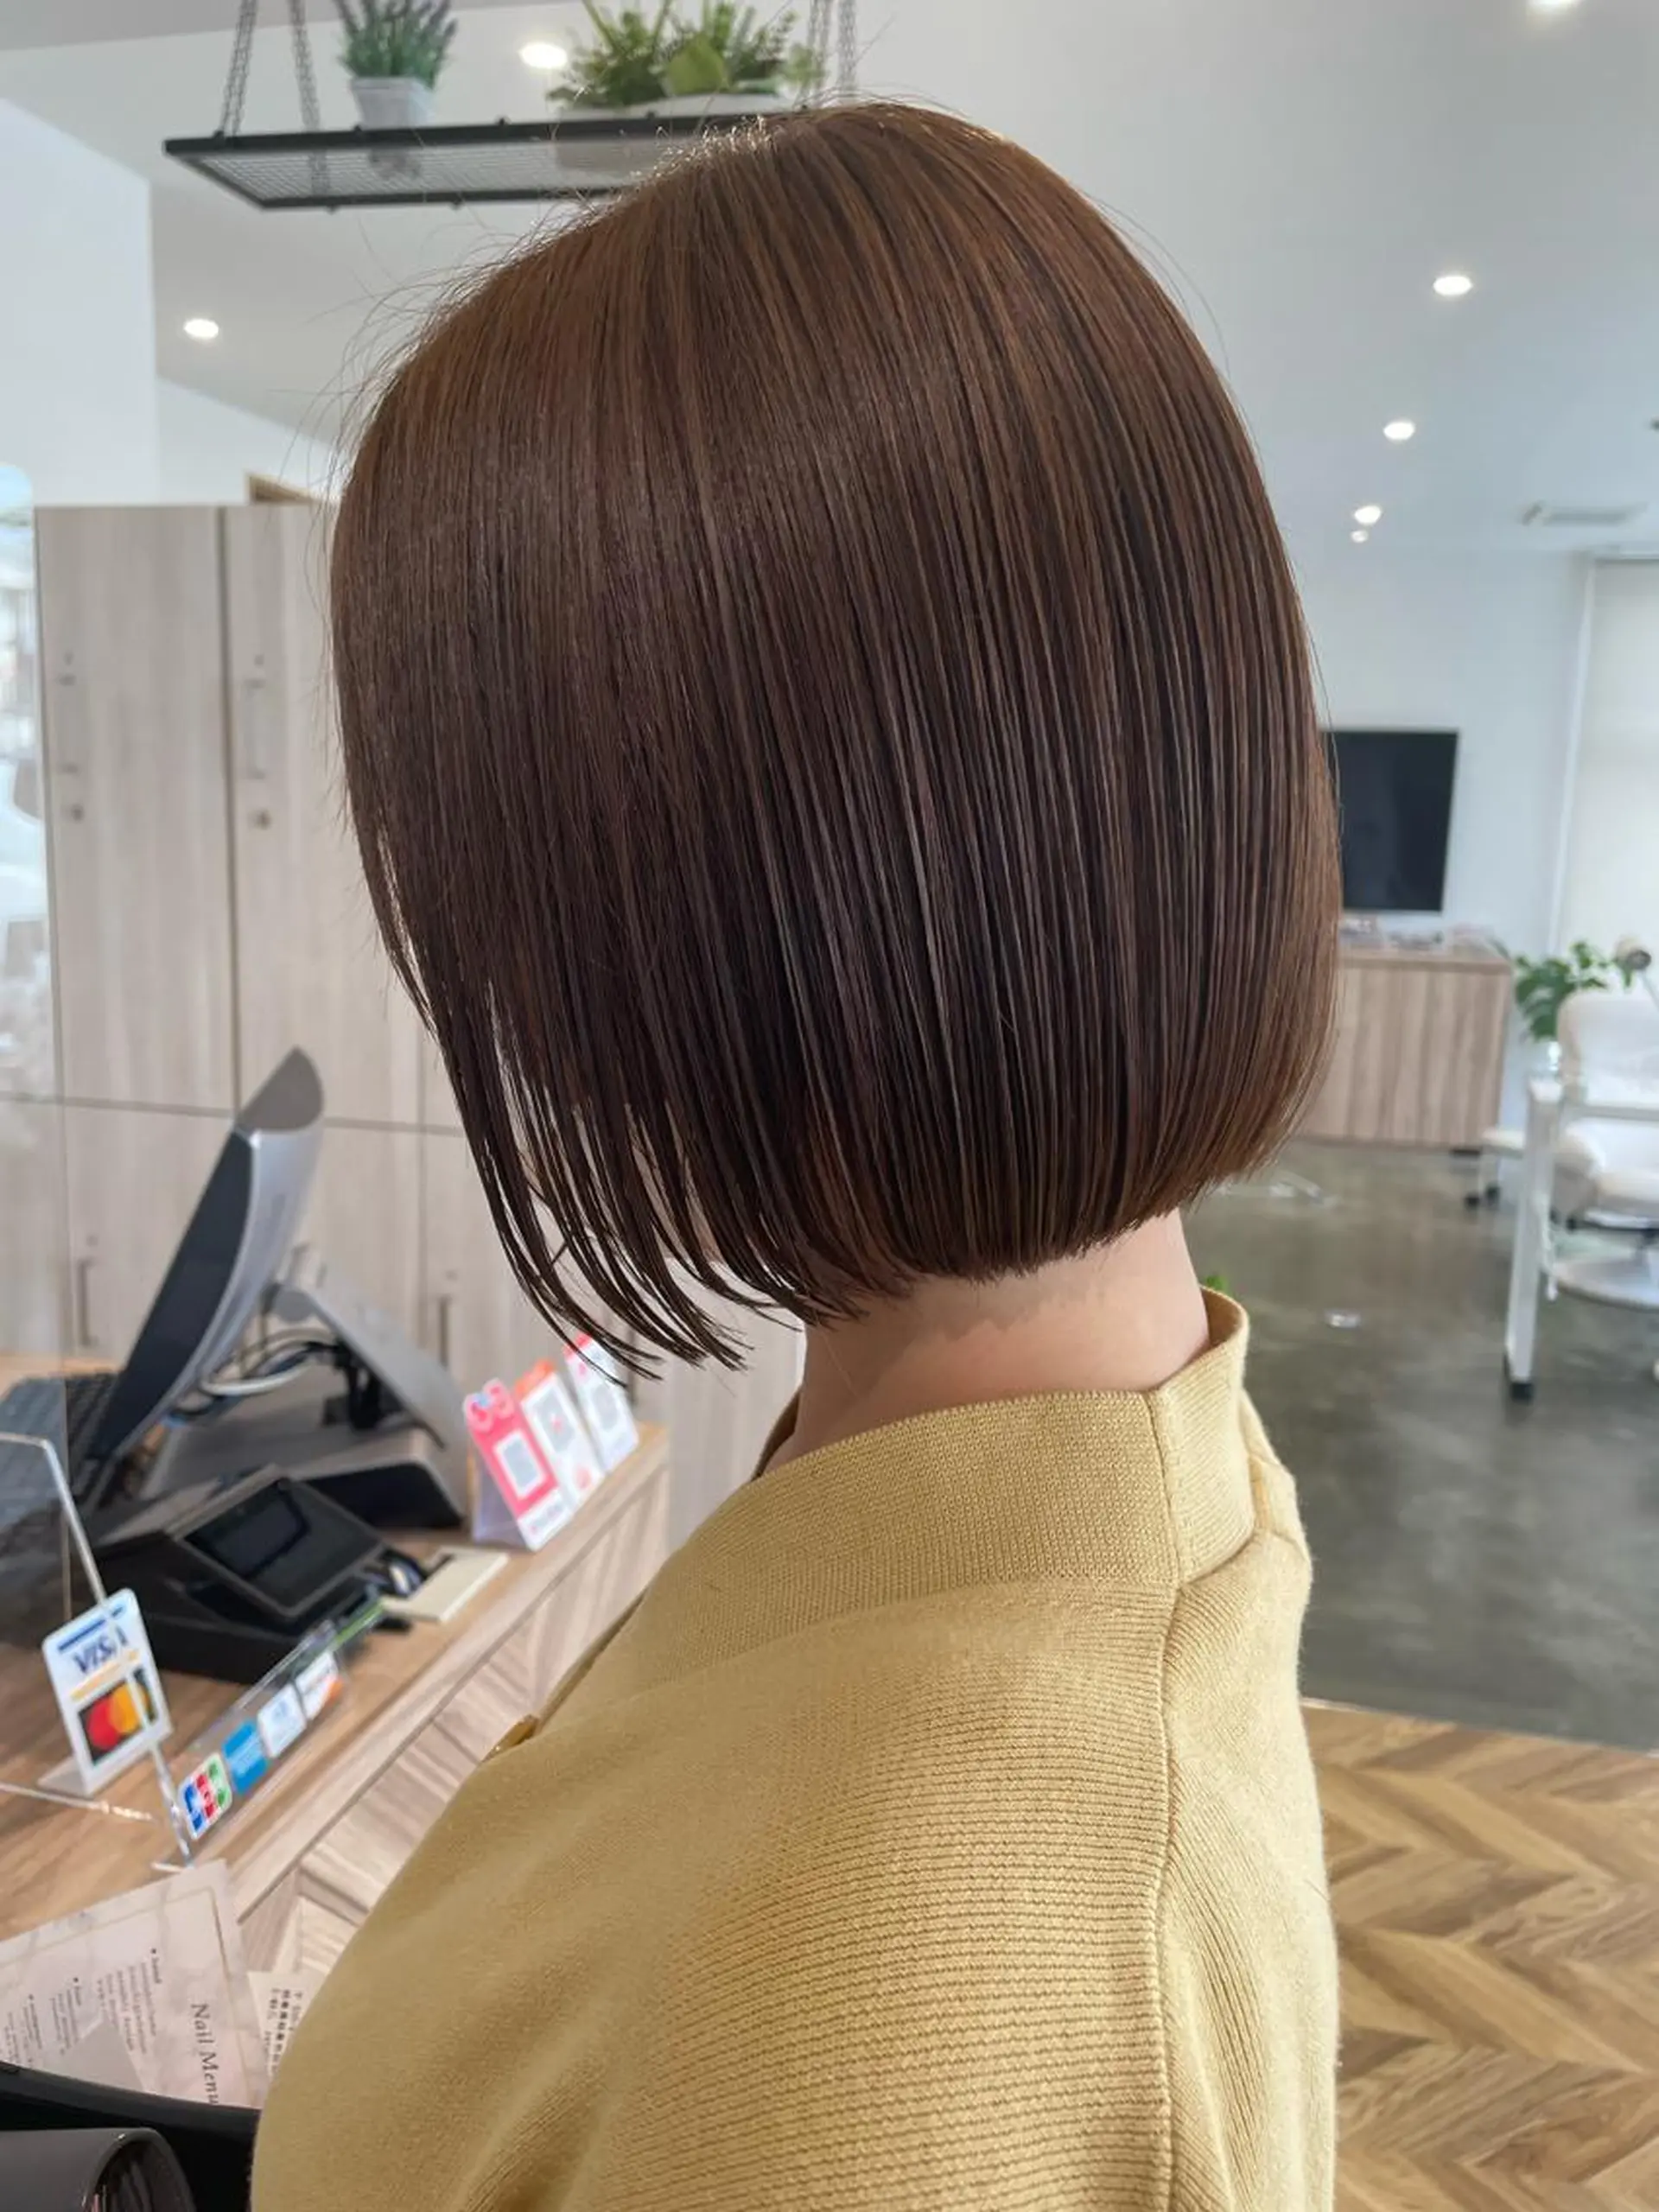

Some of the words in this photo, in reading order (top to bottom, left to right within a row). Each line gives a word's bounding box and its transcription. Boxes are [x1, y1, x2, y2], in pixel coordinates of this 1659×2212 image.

[73, 1624, 129, 1674] VISA
[191, 2004, 214, 2044] Nail
[199, 2051, 219, 2104] Menu
